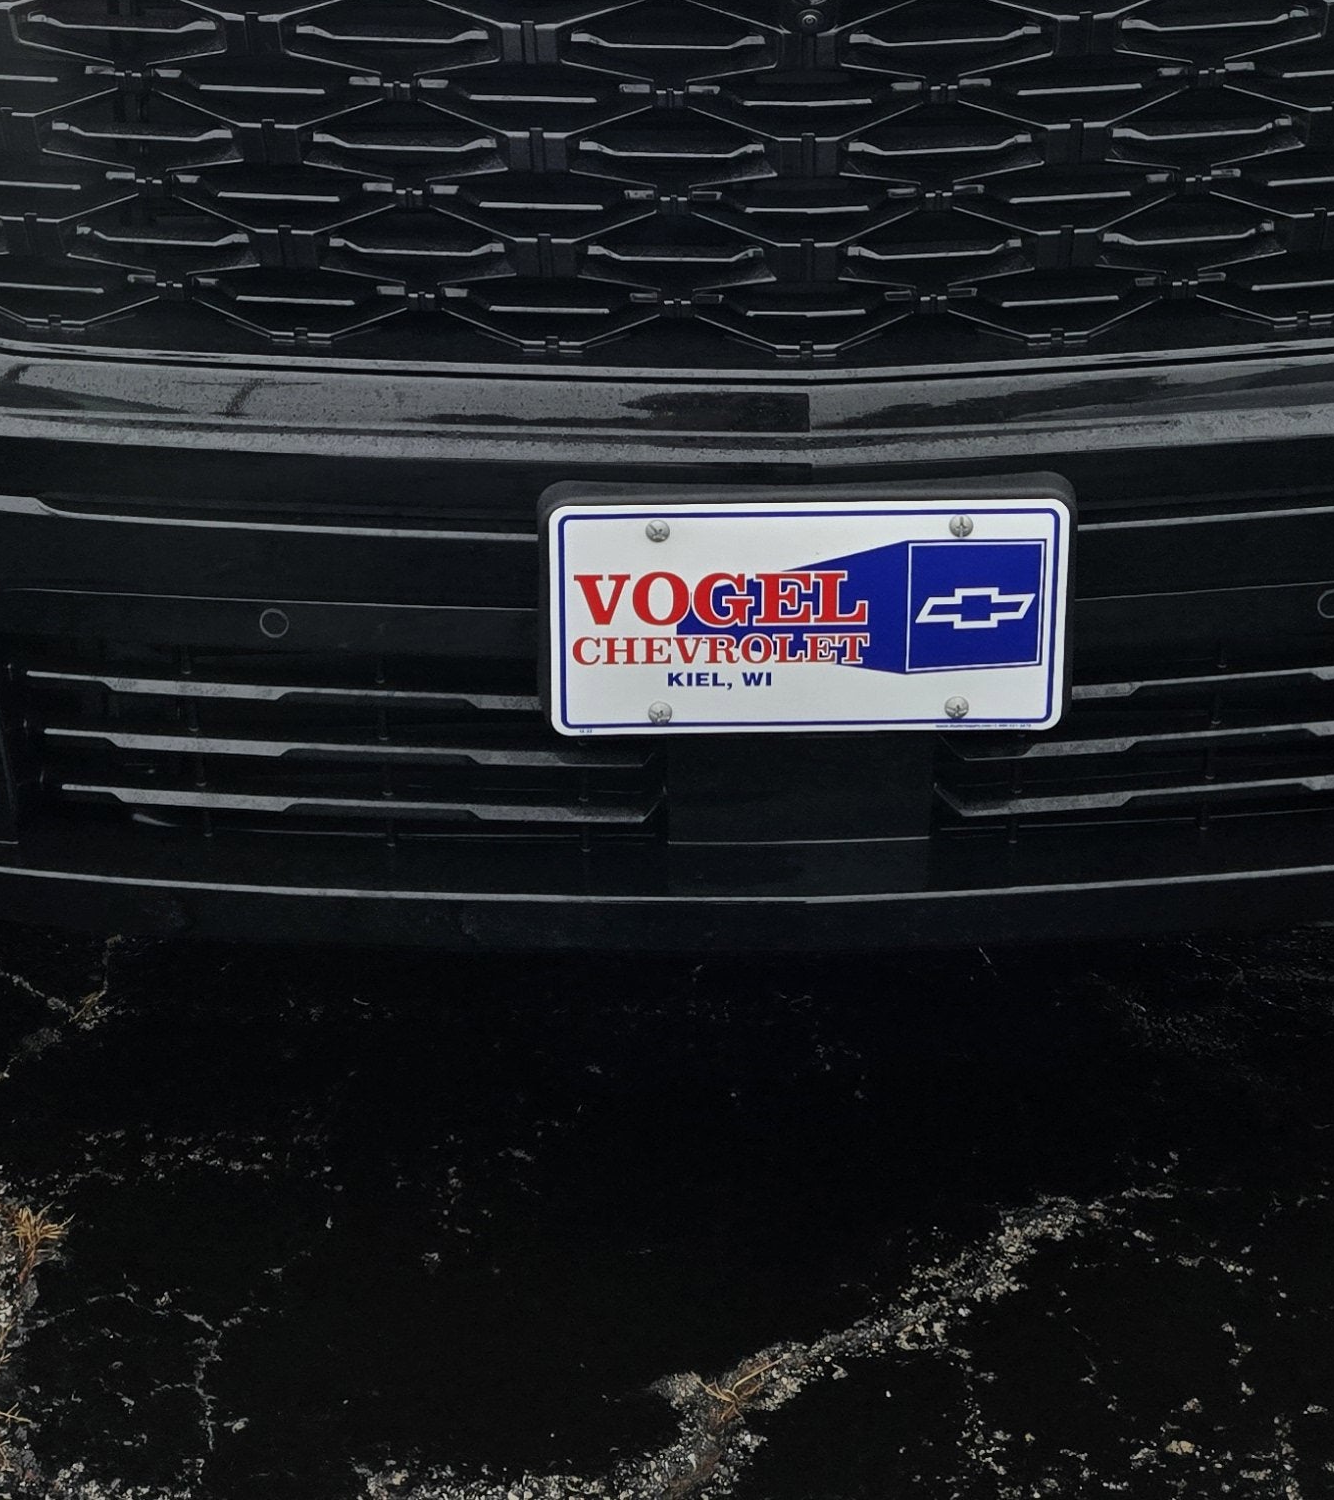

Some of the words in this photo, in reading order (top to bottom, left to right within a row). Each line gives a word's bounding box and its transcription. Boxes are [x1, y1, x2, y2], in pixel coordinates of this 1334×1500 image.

[573, 570, 868, 627] VOGEL
[572, 633, 870, 665] CHEVROLET
[667, 672, 733, 690] KIEL,
[742, 672, 772, 687] WI
